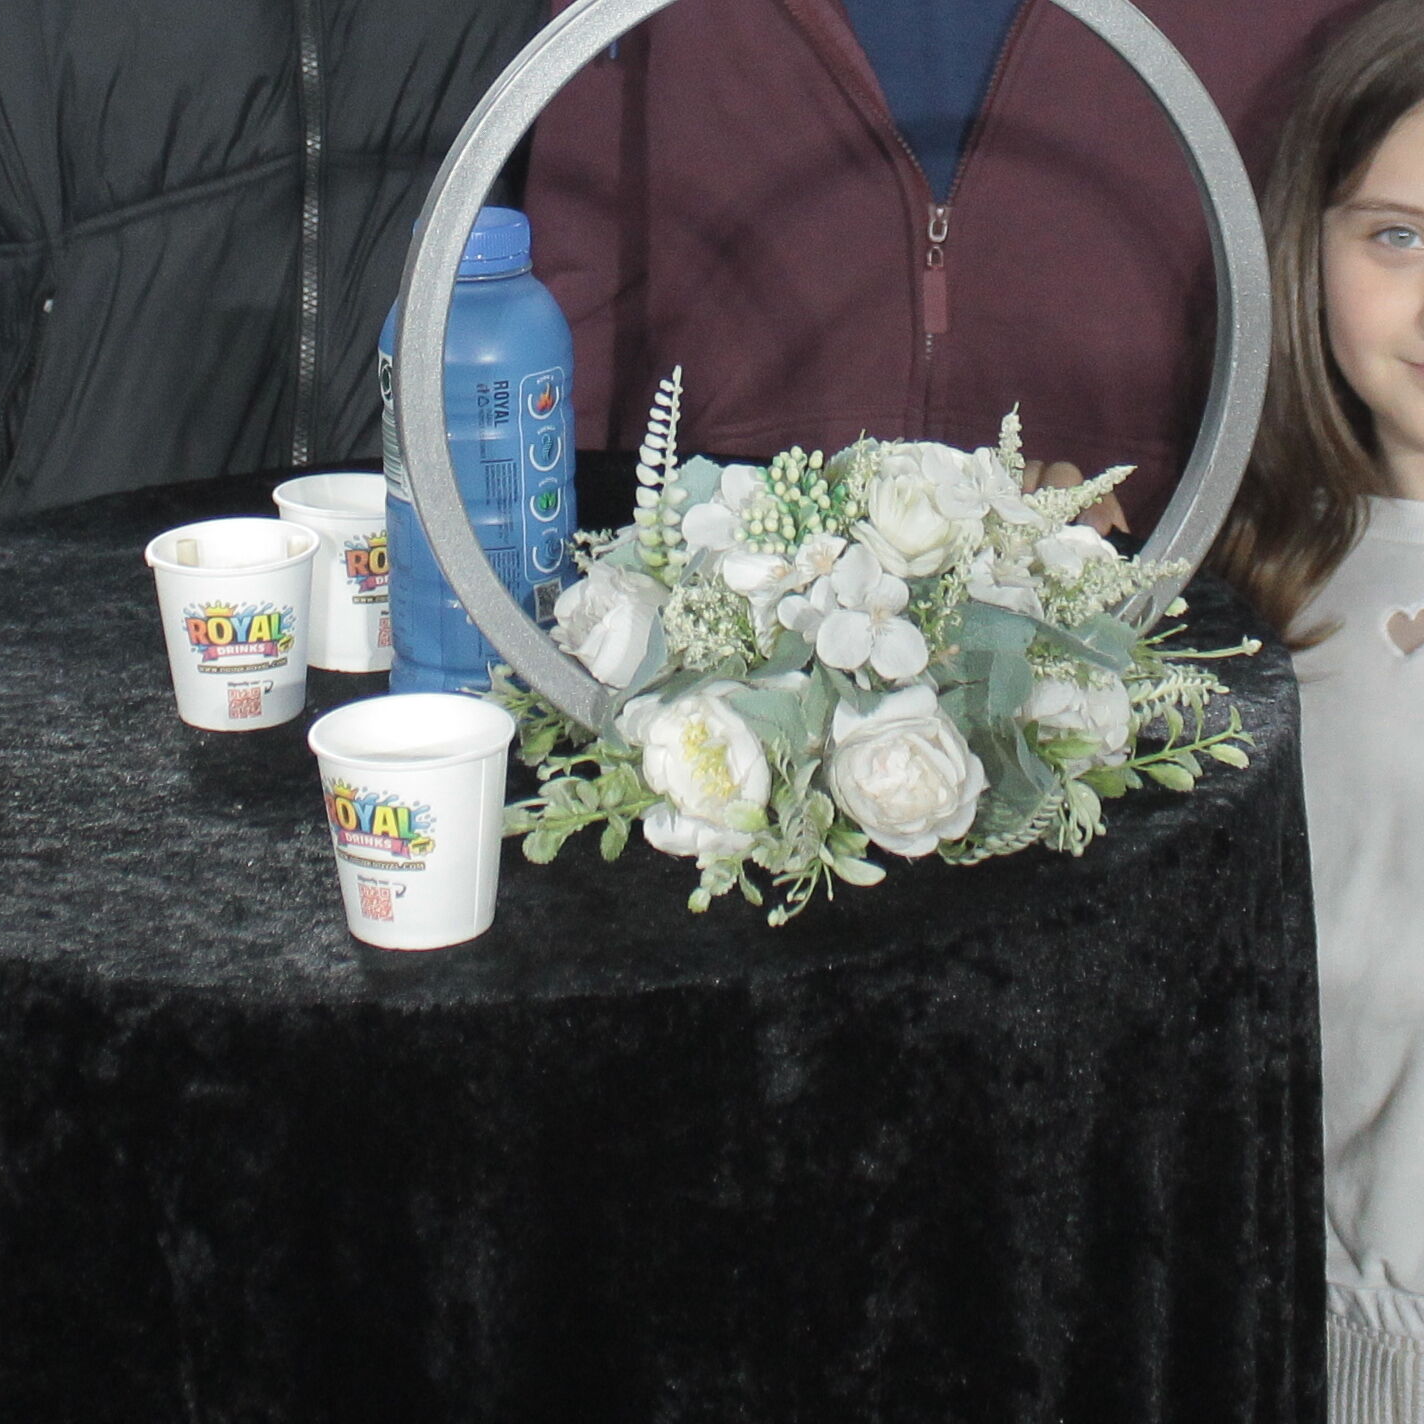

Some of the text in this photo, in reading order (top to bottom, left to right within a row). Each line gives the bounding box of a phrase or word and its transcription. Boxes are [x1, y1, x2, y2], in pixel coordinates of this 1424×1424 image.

[493, 380, 510, 428] ROYAL
[185, 611, 285, 647] ROYAL
[216, 644, 266, 656] DRINKS
[344, 830, 394, 851] DRINKS
